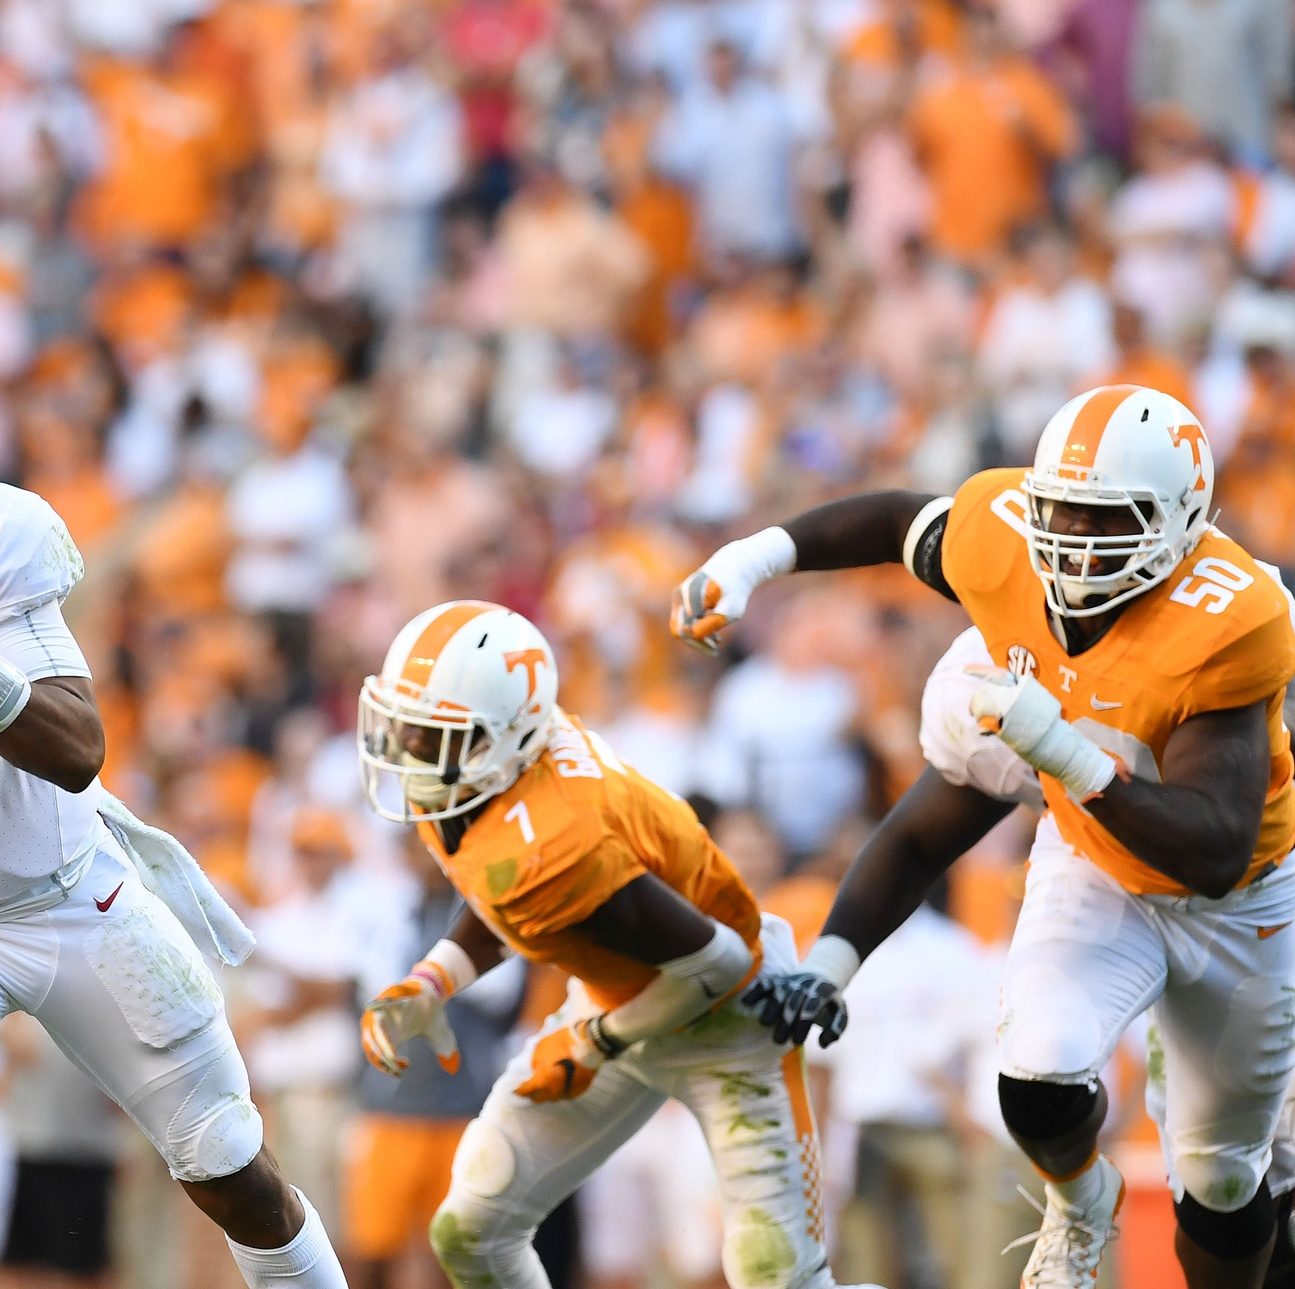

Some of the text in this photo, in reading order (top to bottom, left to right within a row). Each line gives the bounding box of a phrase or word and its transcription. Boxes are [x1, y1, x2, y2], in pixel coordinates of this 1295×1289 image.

[1168, 425, 1207, 491] T
[1168, 556, 1255, 615] 50
[502, 648, 548, 716] T
[1058, 664, 1078, 694] T
[503, 799, 536, 845] 7
